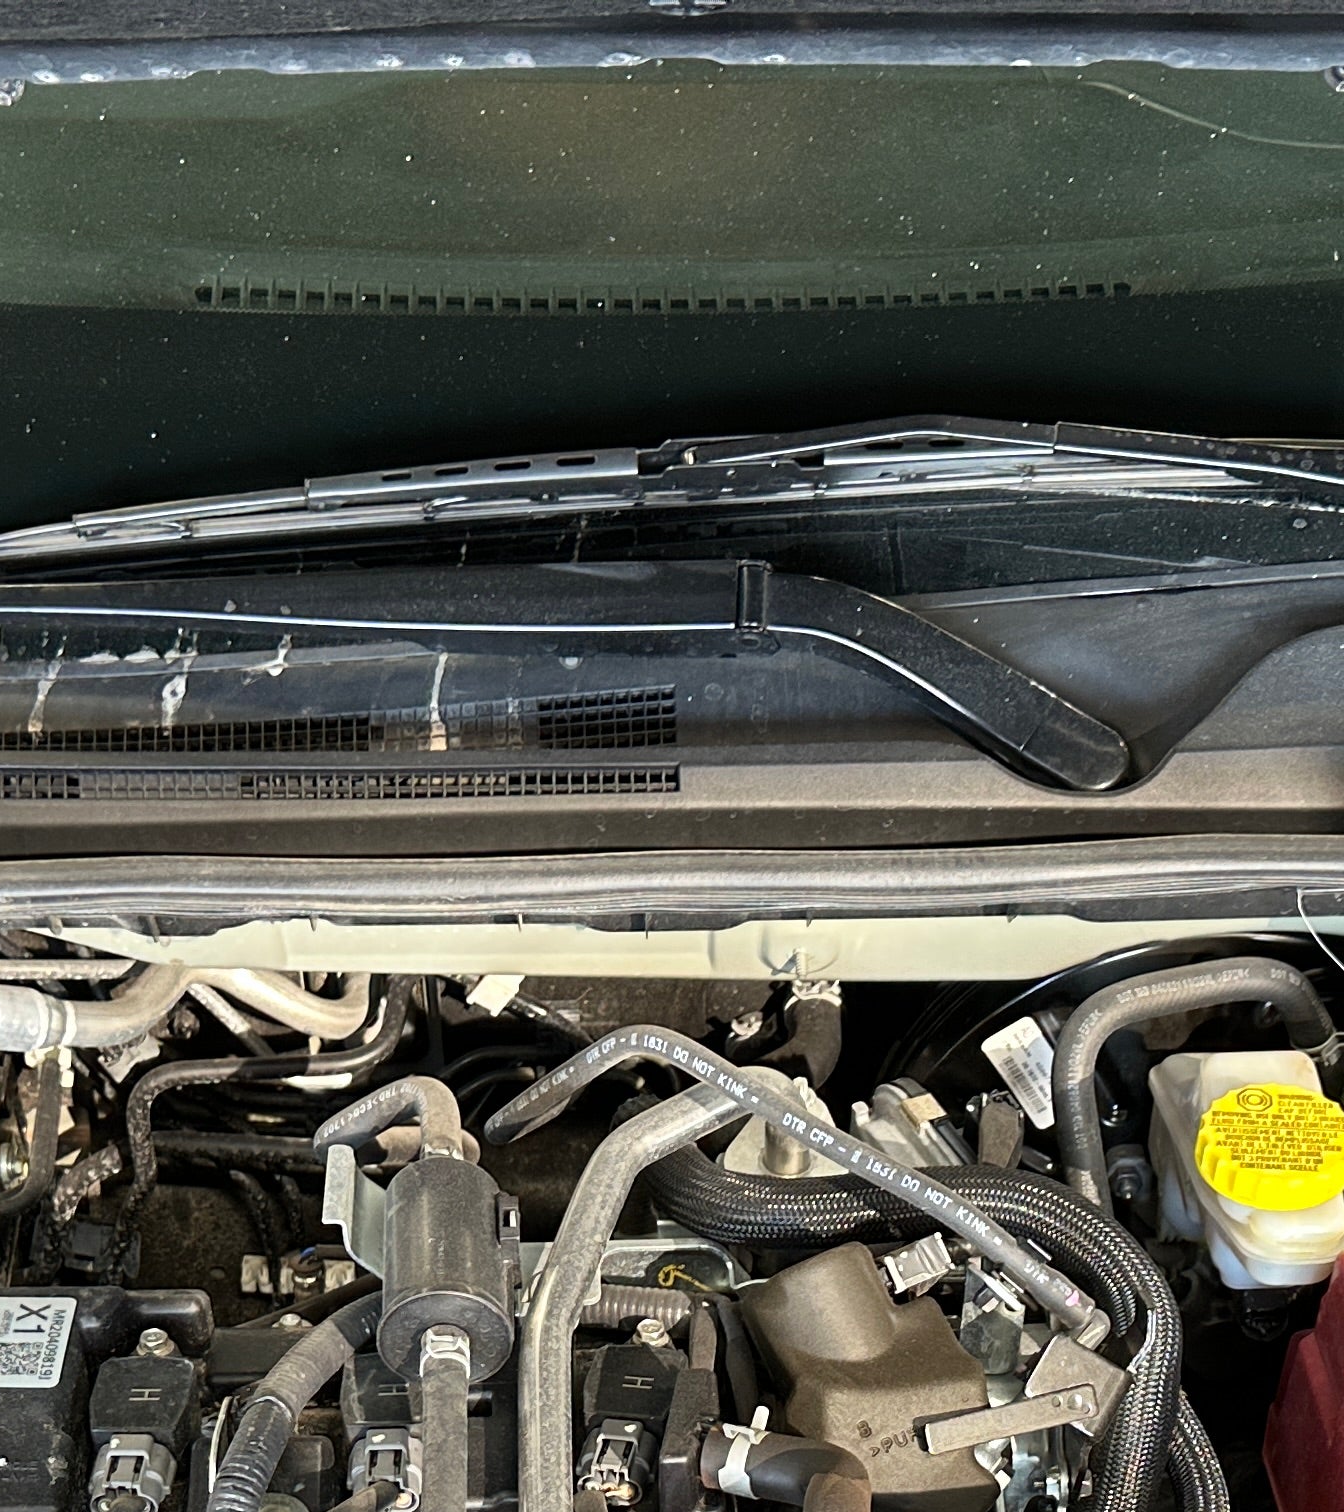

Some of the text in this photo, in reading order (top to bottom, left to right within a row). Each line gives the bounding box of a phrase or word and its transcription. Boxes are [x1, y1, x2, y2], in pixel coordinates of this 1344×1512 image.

[691, 1056, 716, 1079] NOT
[716, 1074, 749, 1100] KINK
[782, 1111, 807, 1135] DTR
[901, 1174, 922, 1194] DO
[923, 1189, 954, 1210] NOT
[955, 1203, 993, 1239] KINK
[12, 1303, 52, 1333] X1
